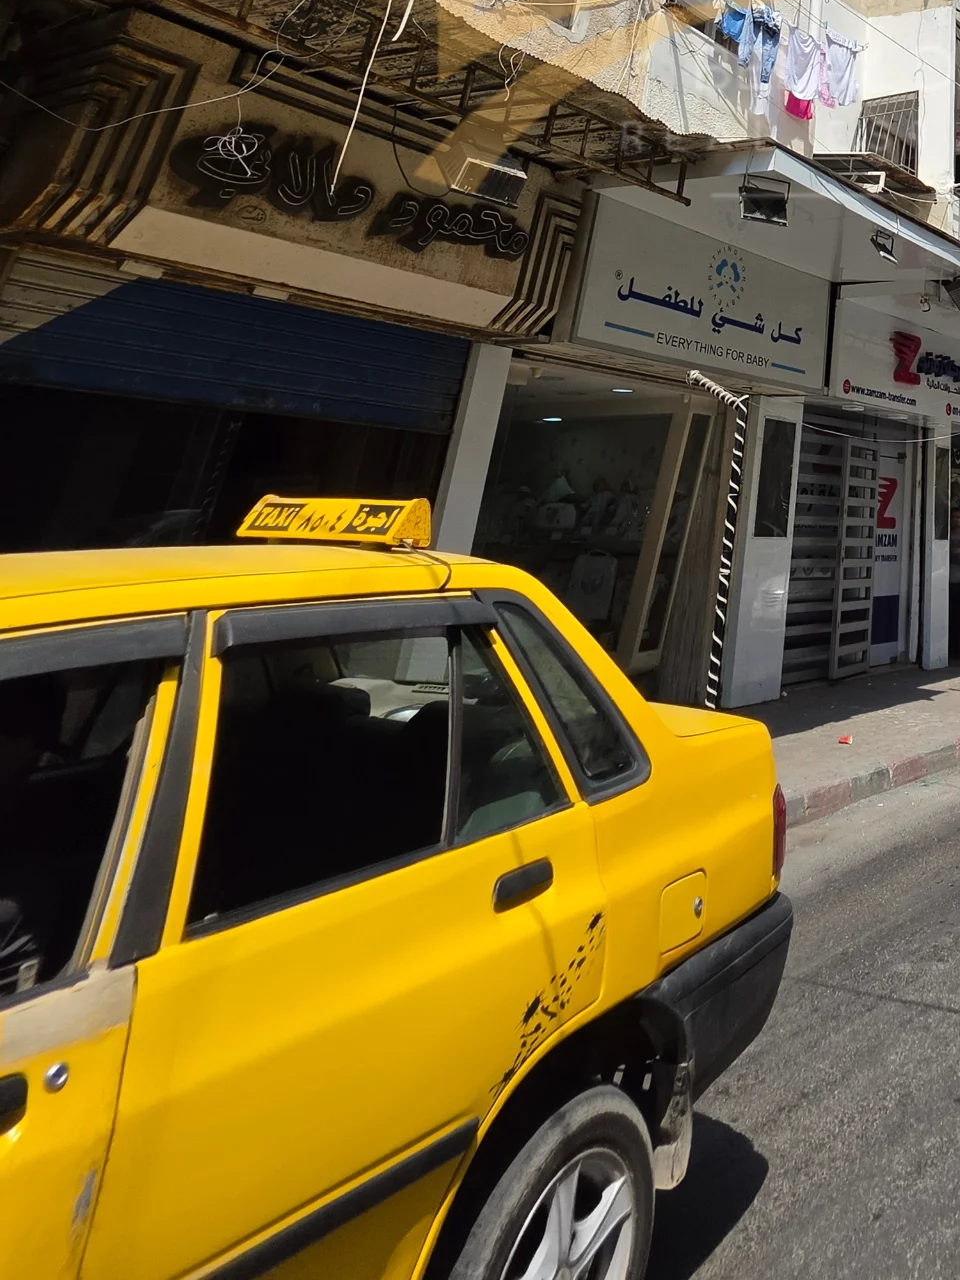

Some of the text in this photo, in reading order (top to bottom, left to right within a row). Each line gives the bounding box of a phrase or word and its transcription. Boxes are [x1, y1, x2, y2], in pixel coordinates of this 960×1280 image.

[385, 197, 530, 257] محمود
[617, 276, 704, 318] للطفل
[770, 320, 803, 345] كل
[725, 348, 745, 363] FOR
[746, 353, 770, 368] BABY
[850, 384, 917, 407] www.zamzam-transfer.com
